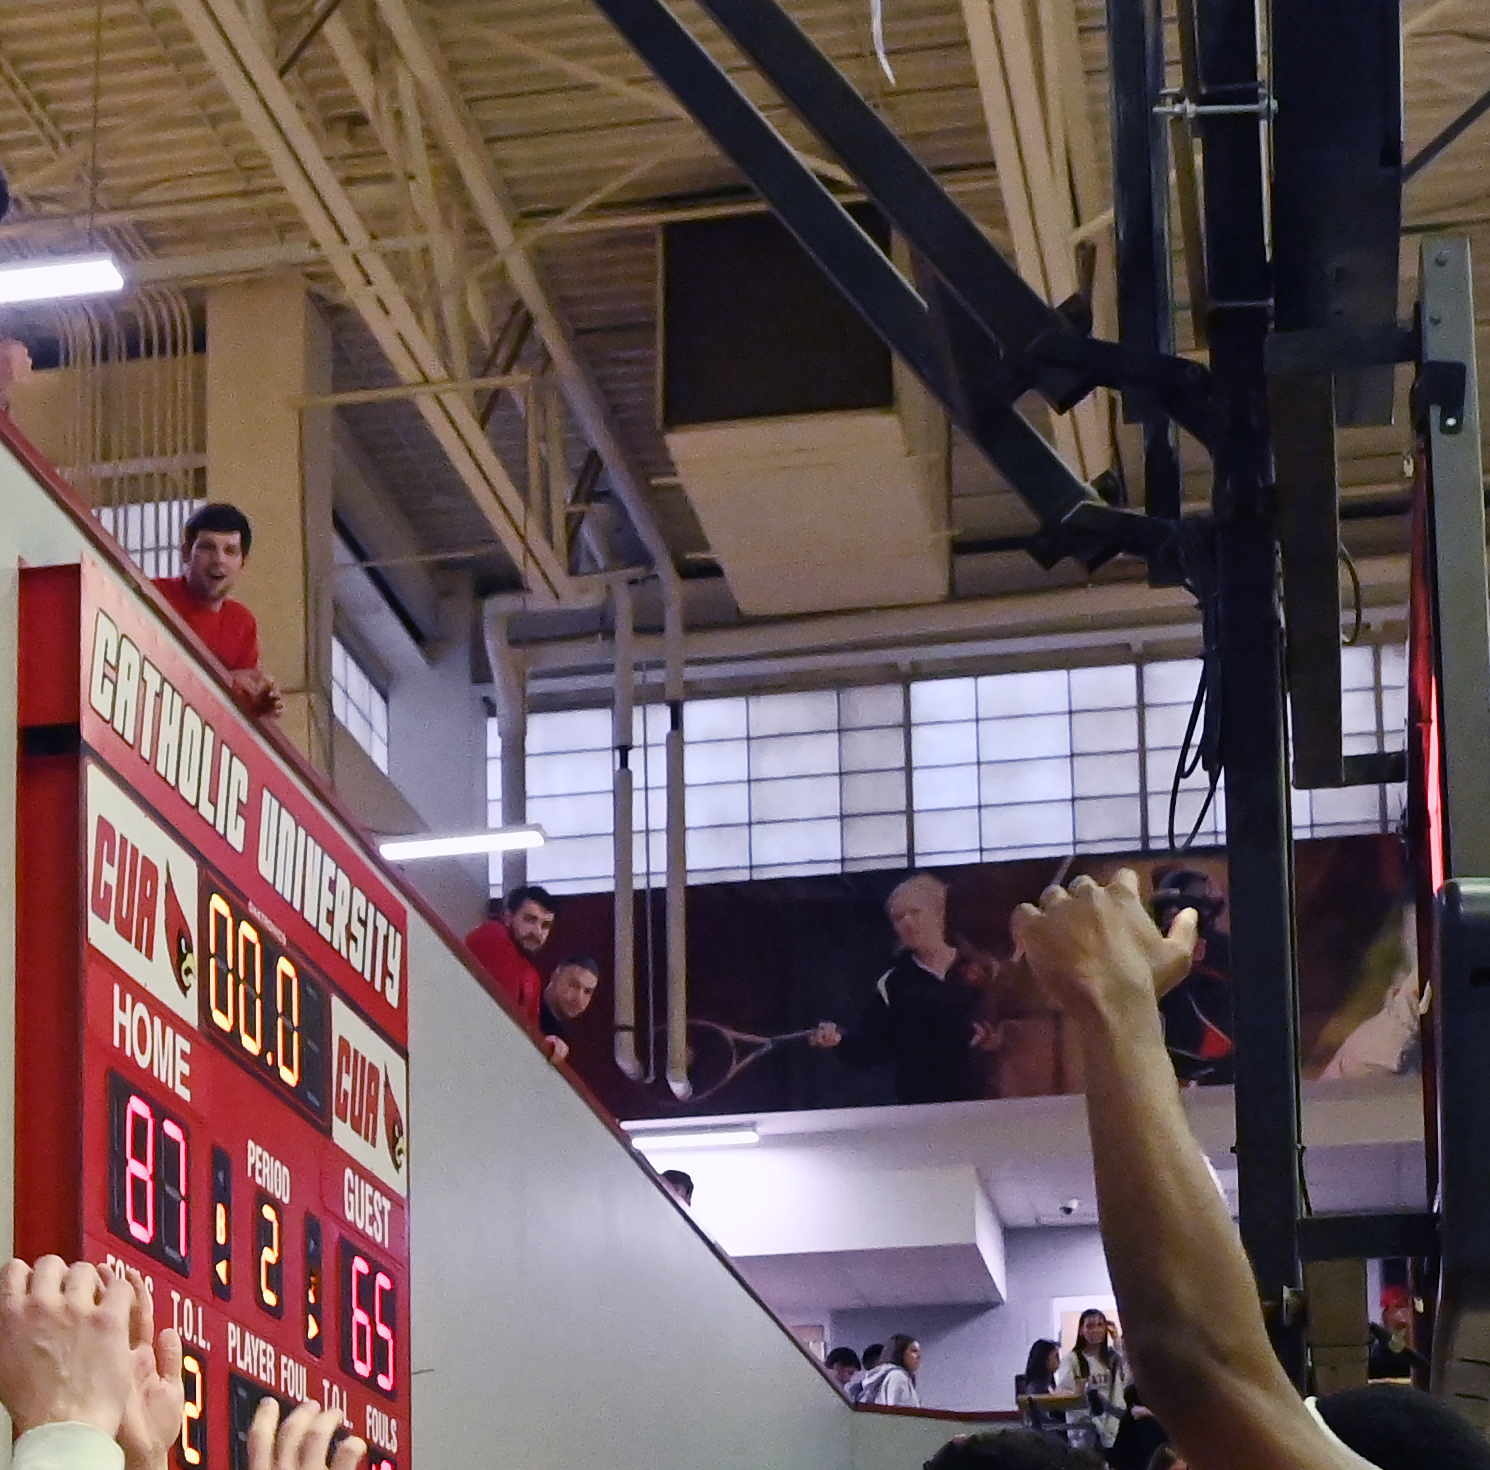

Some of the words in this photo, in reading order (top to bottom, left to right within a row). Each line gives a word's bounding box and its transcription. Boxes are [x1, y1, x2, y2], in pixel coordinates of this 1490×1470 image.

[90, 608, 250, 853] CATHOLIC
[257, 786, 402, 1009] UNIVERSITY
[91, 814, 159, 960] CUA
[112, 981, 192, 1102] HOME
[335, 1034, 381, 1148] CUA
[125, 1094, 187, 1258] 87
[246, 1138, 291, 1205] PERIOD
[343, 1166, 392, 1248] GUEST
[260, 1203, 279, 1307] 2
[171, 1289, 211, 1351] T.O.L.
[227, 1321, 276, 1387] PLAYER
[280, 1354, 311, 1402] FOUL
[351, 1254, 394, 1392] 65
[182, 1355, 202, 1465] 2
[322, 1378, 354, 1430] TOL.
[365, 1403, 398, 1454] FOULS
